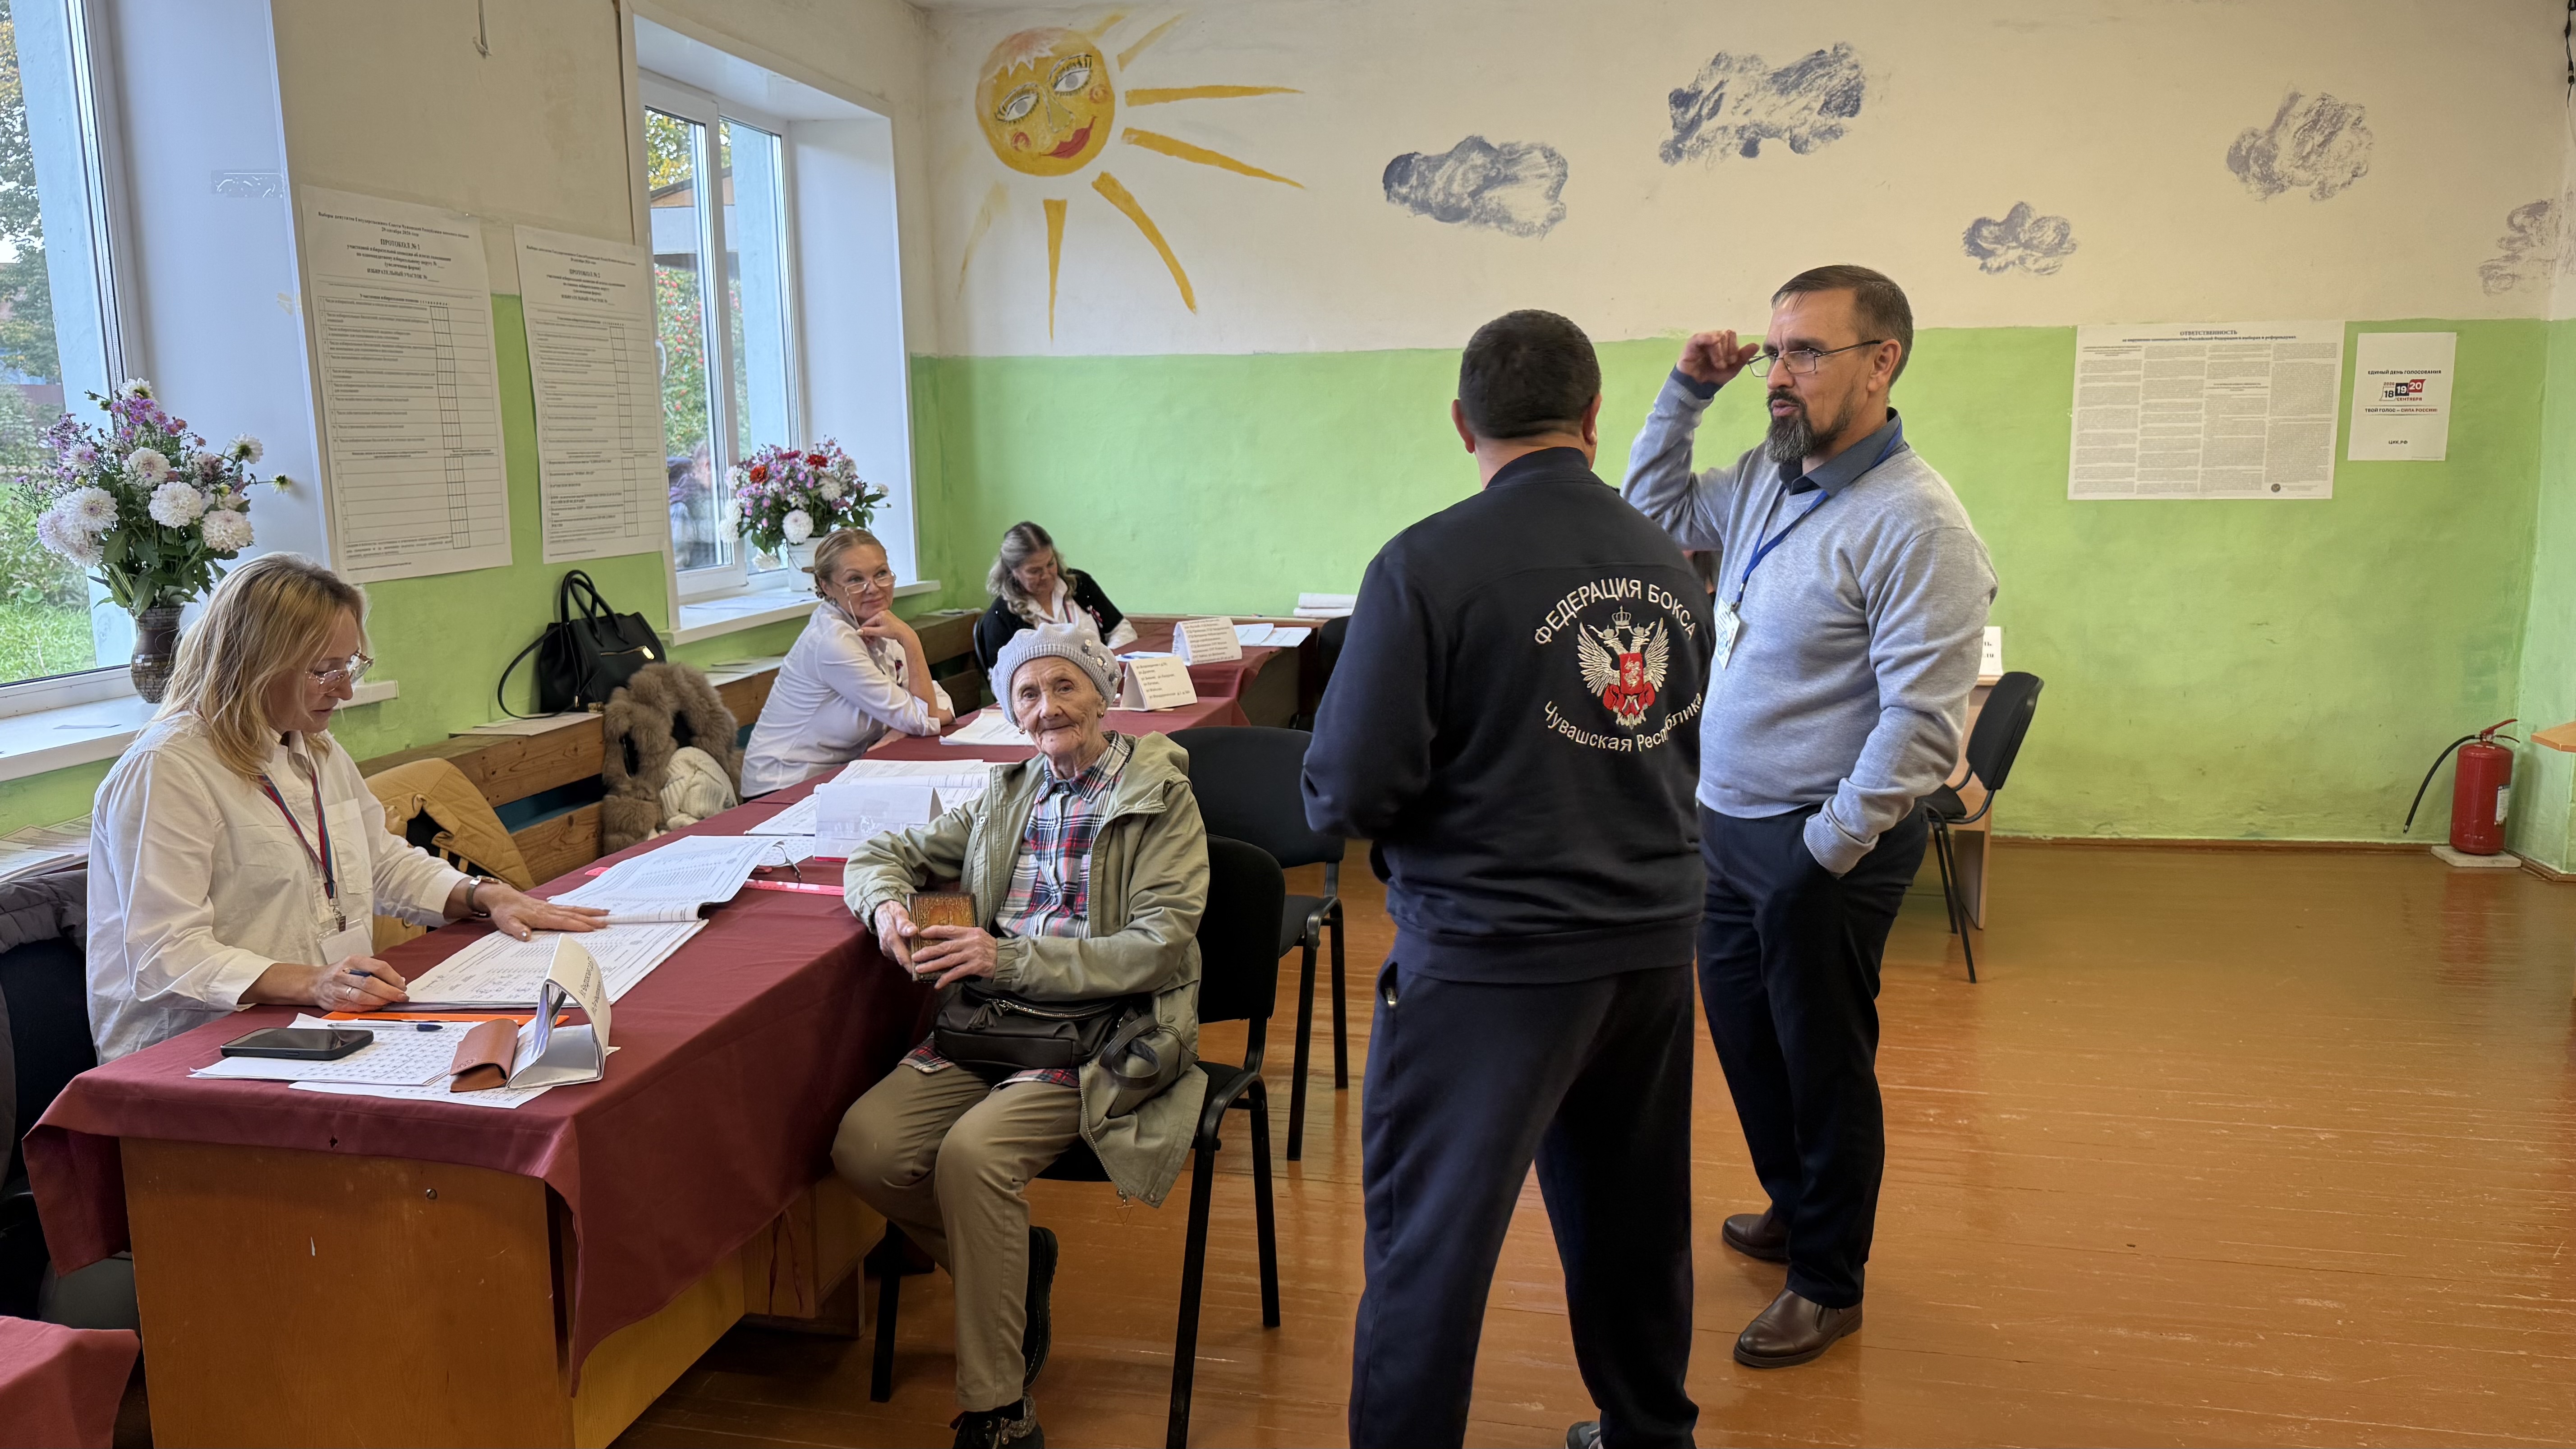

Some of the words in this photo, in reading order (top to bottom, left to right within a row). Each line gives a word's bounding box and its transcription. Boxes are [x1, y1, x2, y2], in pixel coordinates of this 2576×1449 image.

[381, 239, 410, 249] ПРОТОКОЛ
[2396, 386, 2407, 394] 19
[2409, 382, 2422, 390] 20
[1534, 577, 1642, 645] ФЕДЕРАЦИЯ
[1648, 584, 1696, 640] БОКСА
[1544, 700, 1632, 752] Чувашская
